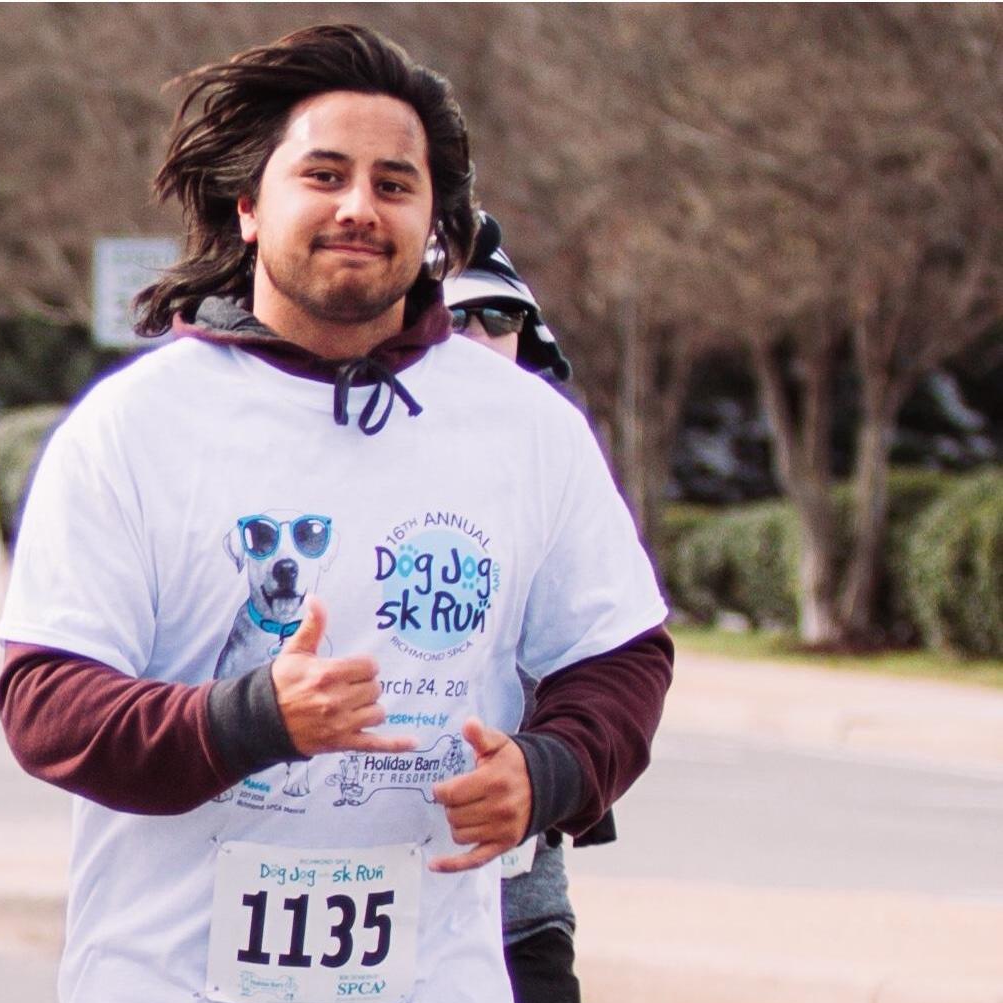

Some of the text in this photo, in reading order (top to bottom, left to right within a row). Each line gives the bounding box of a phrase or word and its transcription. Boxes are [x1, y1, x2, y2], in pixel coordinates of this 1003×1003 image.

[386, 511, 491, 553] 16TH ANNUAL
[375, 545, 492, 599] Dog Jog
[431, 591, 487, 633] Run
[390, 636, 473, 661] RICHMOND SPCA
[385, 712, 436, 728] resented
[364, 756, 440, 771] Holiday Barn
[362, 772, 384, 783] PET
[260, 863, 287, 885] Dog
[289, 866, 316, 887] Jog
[356, 864, 384, 881] Run
[237, 890, 395, 968] 1135
[337, 980, 386, 996] SPCA
